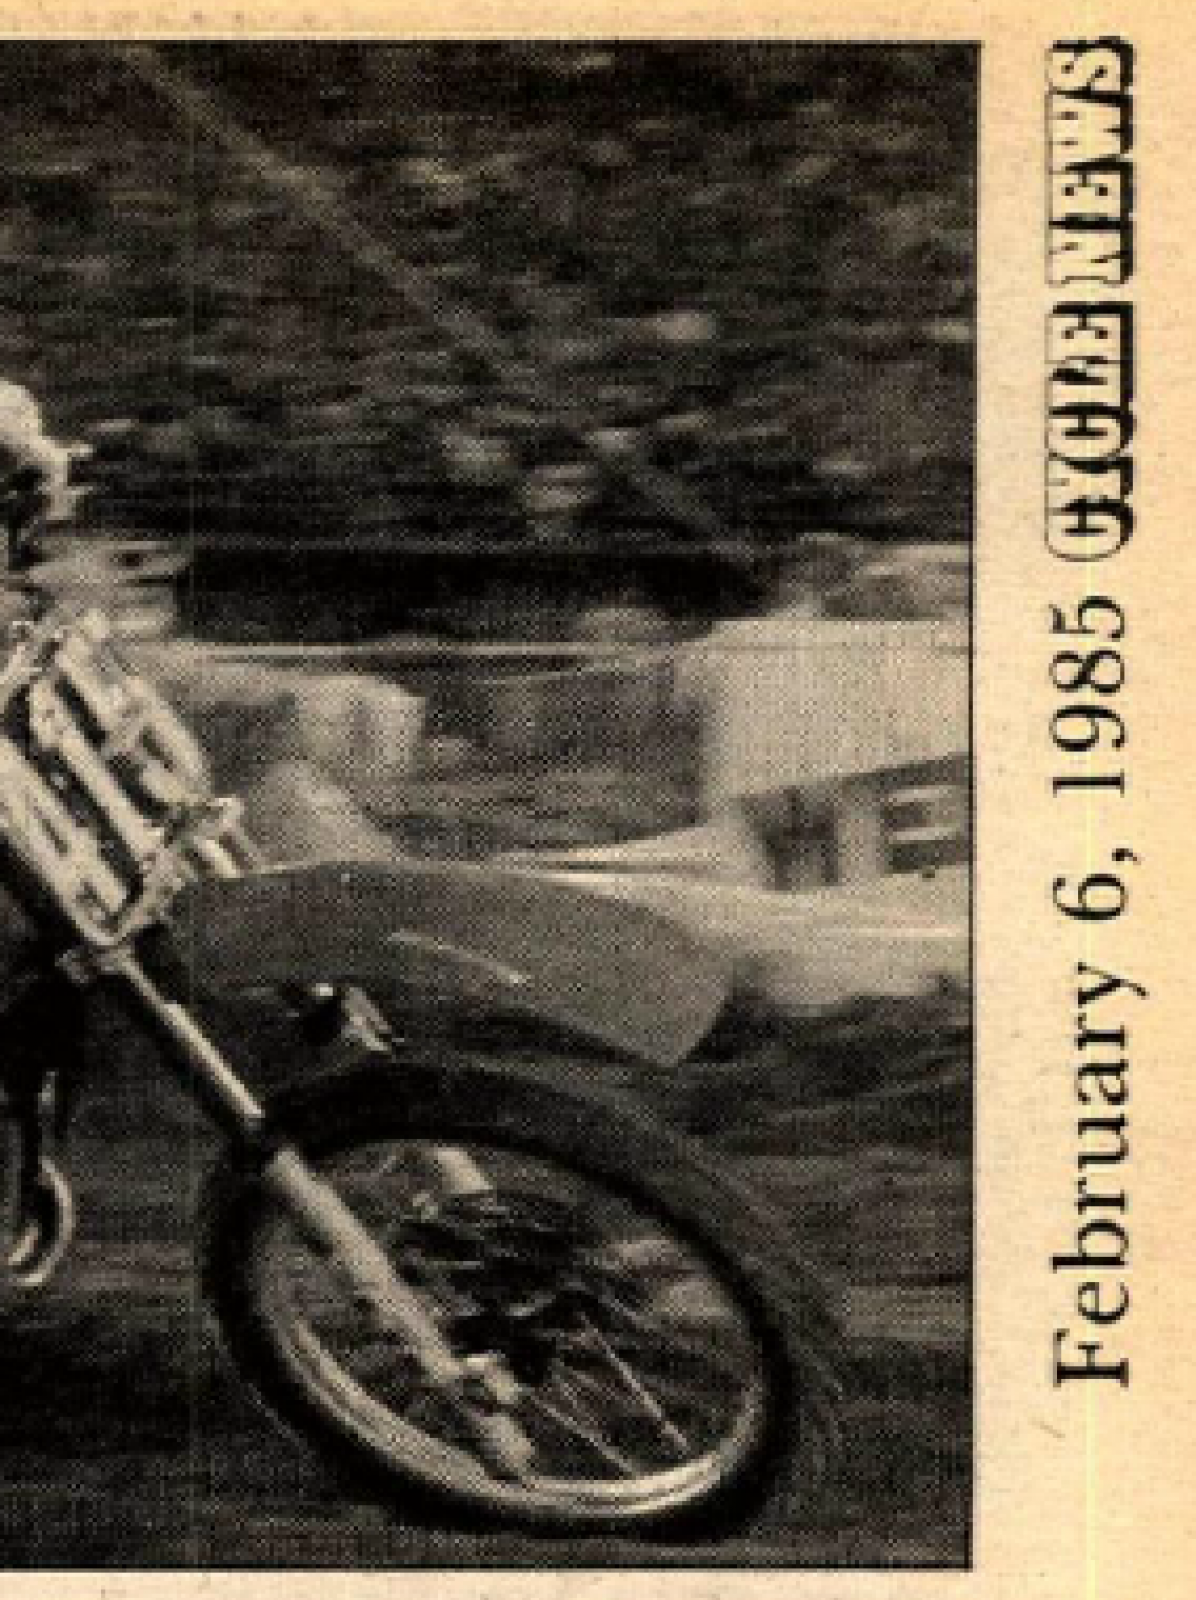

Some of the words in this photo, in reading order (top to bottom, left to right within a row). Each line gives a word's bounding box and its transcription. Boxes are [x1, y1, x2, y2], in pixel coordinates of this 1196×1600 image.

[1043, 35, 1136, 285] NEWS
[1043, 300, 1137, 562] CYCLE
[1048, 595, 1126, 794] 1985
[1052, 847, 1137, 921] 6,
[1050, 961, 1146, 1388] February
